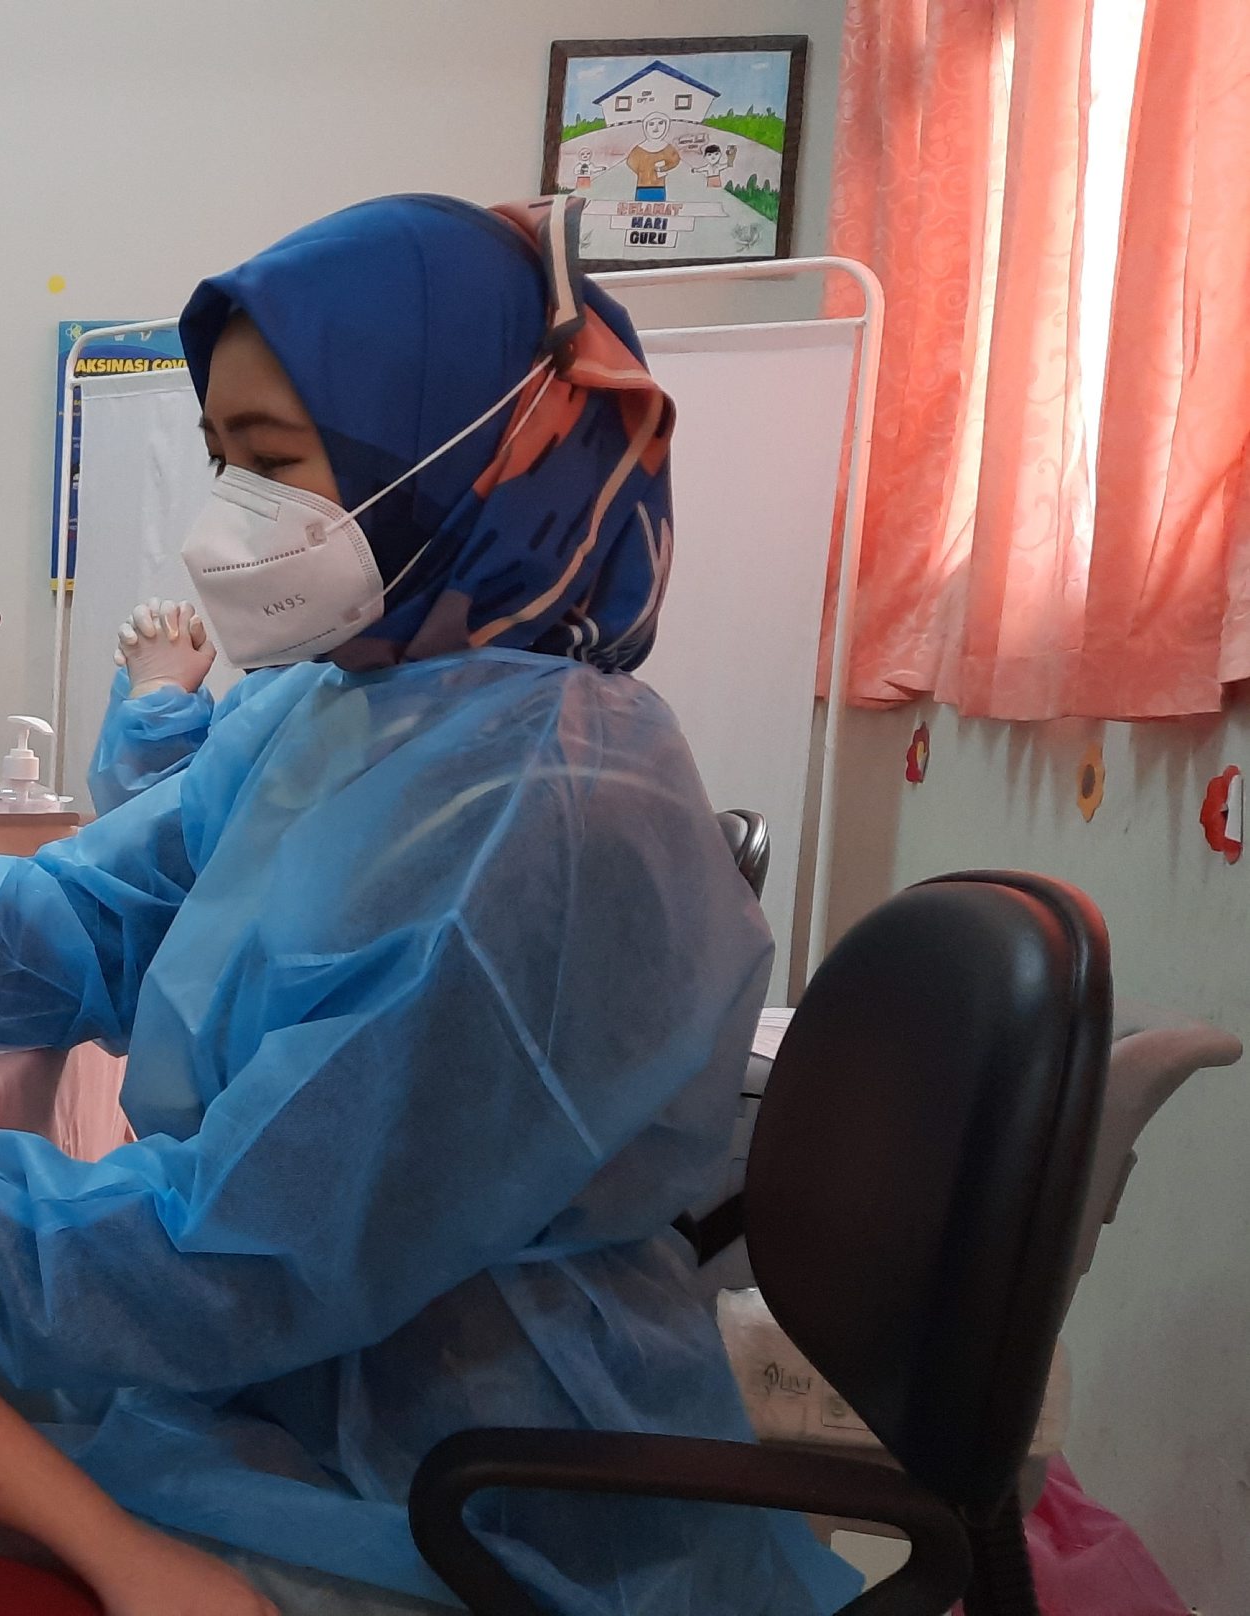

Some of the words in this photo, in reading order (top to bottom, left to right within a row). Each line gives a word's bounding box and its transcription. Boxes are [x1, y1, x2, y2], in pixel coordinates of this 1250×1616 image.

[630, 231, 667, 245] GURU
[75, 358, 150, 373] AKSINASI
[262, 593, 306, 616] KN95
